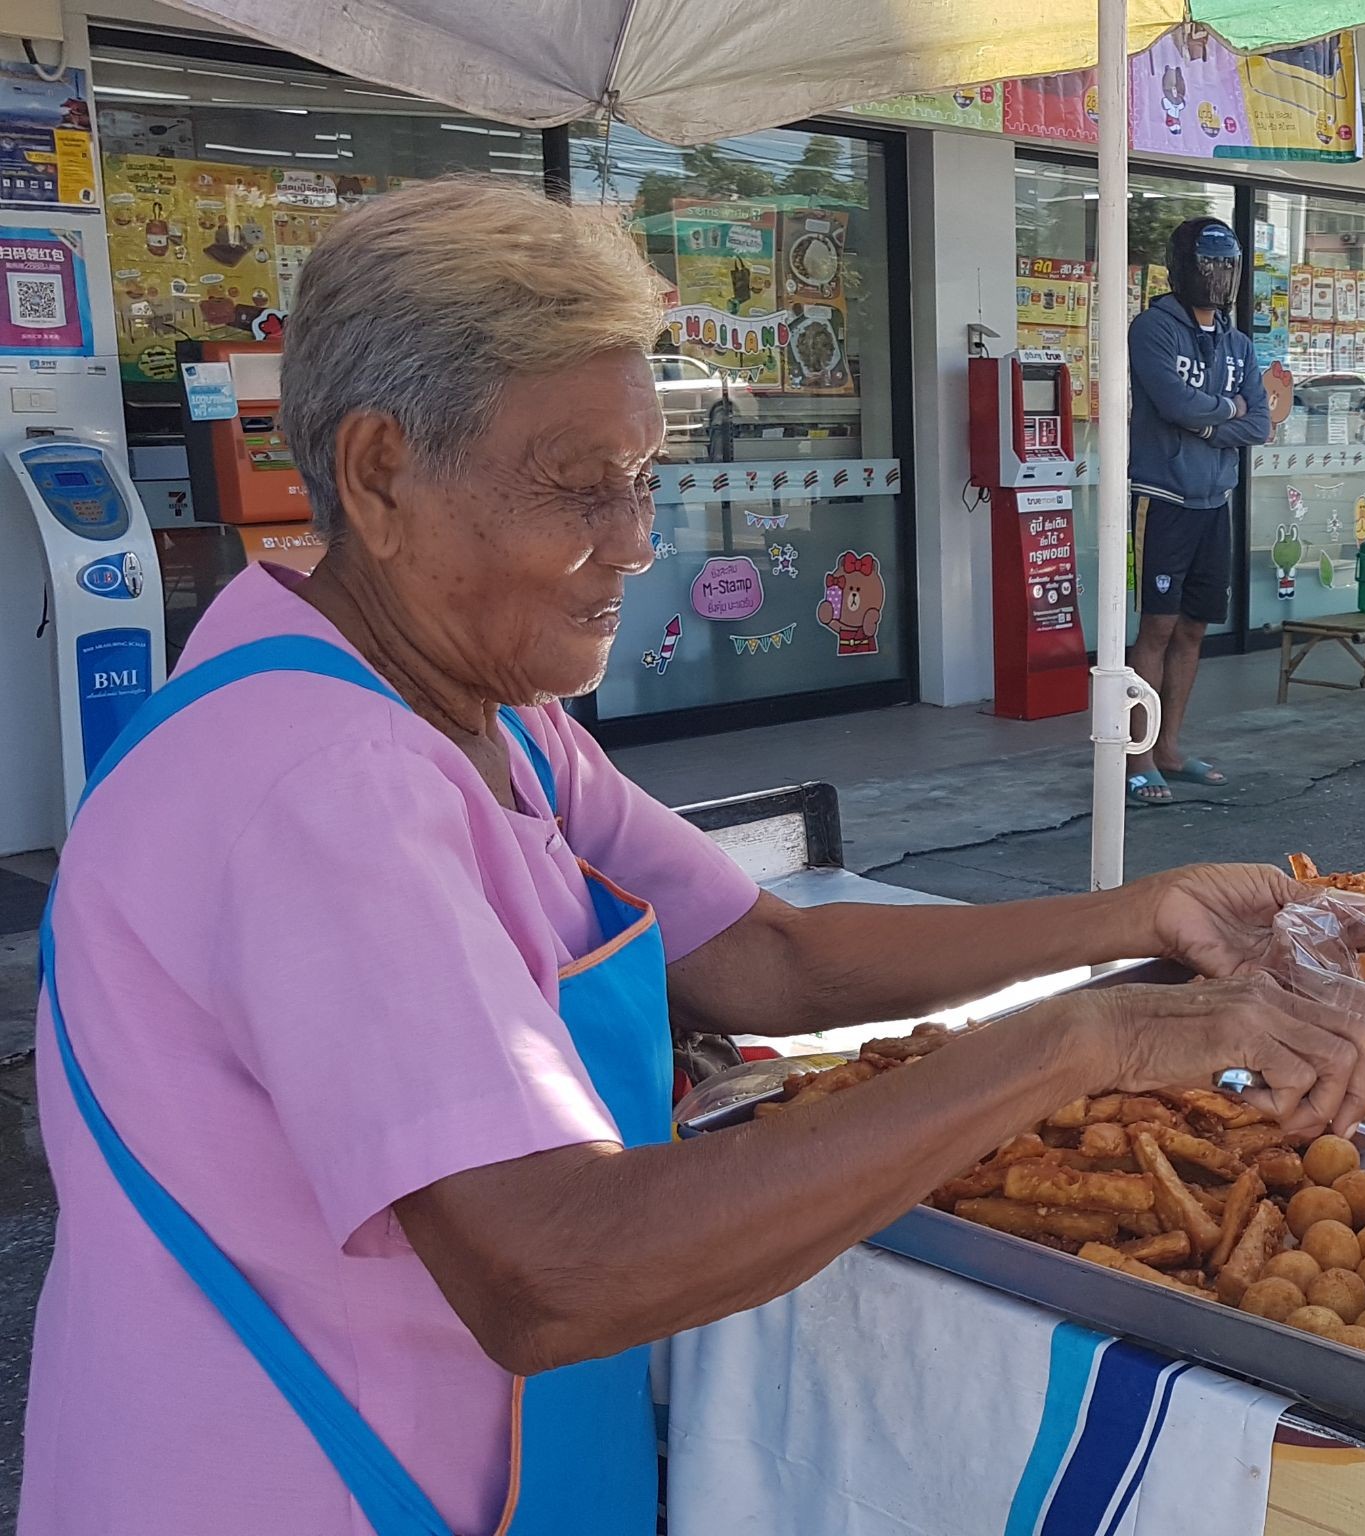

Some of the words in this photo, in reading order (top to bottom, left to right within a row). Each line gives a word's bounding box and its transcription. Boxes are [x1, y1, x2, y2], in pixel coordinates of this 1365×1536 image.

[669, 315, 790, 354] THAILAND
[1045, 352, 1061, 361] true
[702, 578, 752, 598] M-Stamp
[93, 669, 138, 690] BMI
